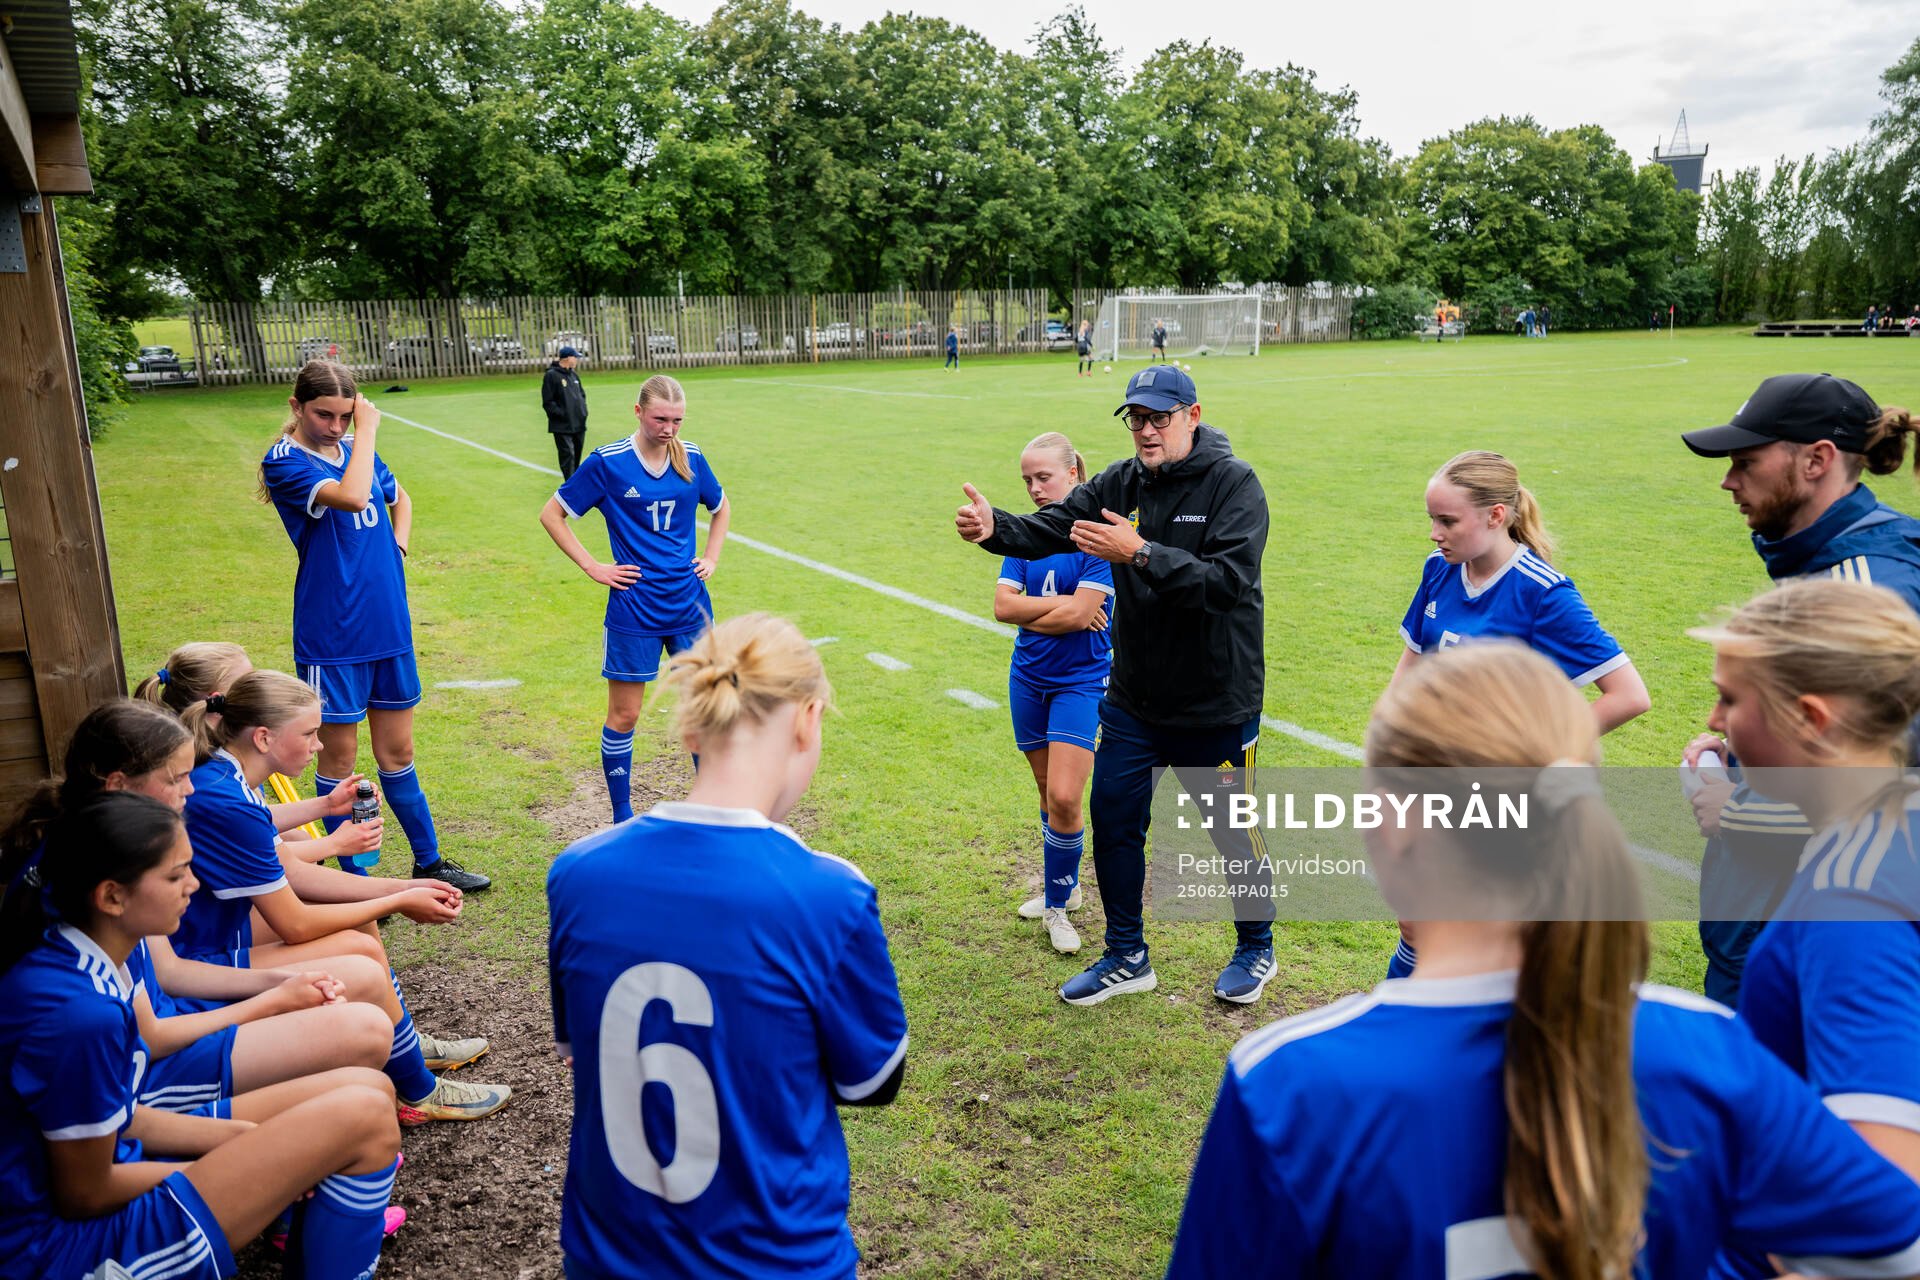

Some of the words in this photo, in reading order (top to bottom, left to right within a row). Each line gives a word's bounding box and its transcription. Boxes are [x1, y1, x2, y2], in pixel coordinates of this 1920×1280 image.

[646, 500, 676, 531] 17
[1042, 570, 1058, 597] 4
[599, 962, 721, 1204] 6
